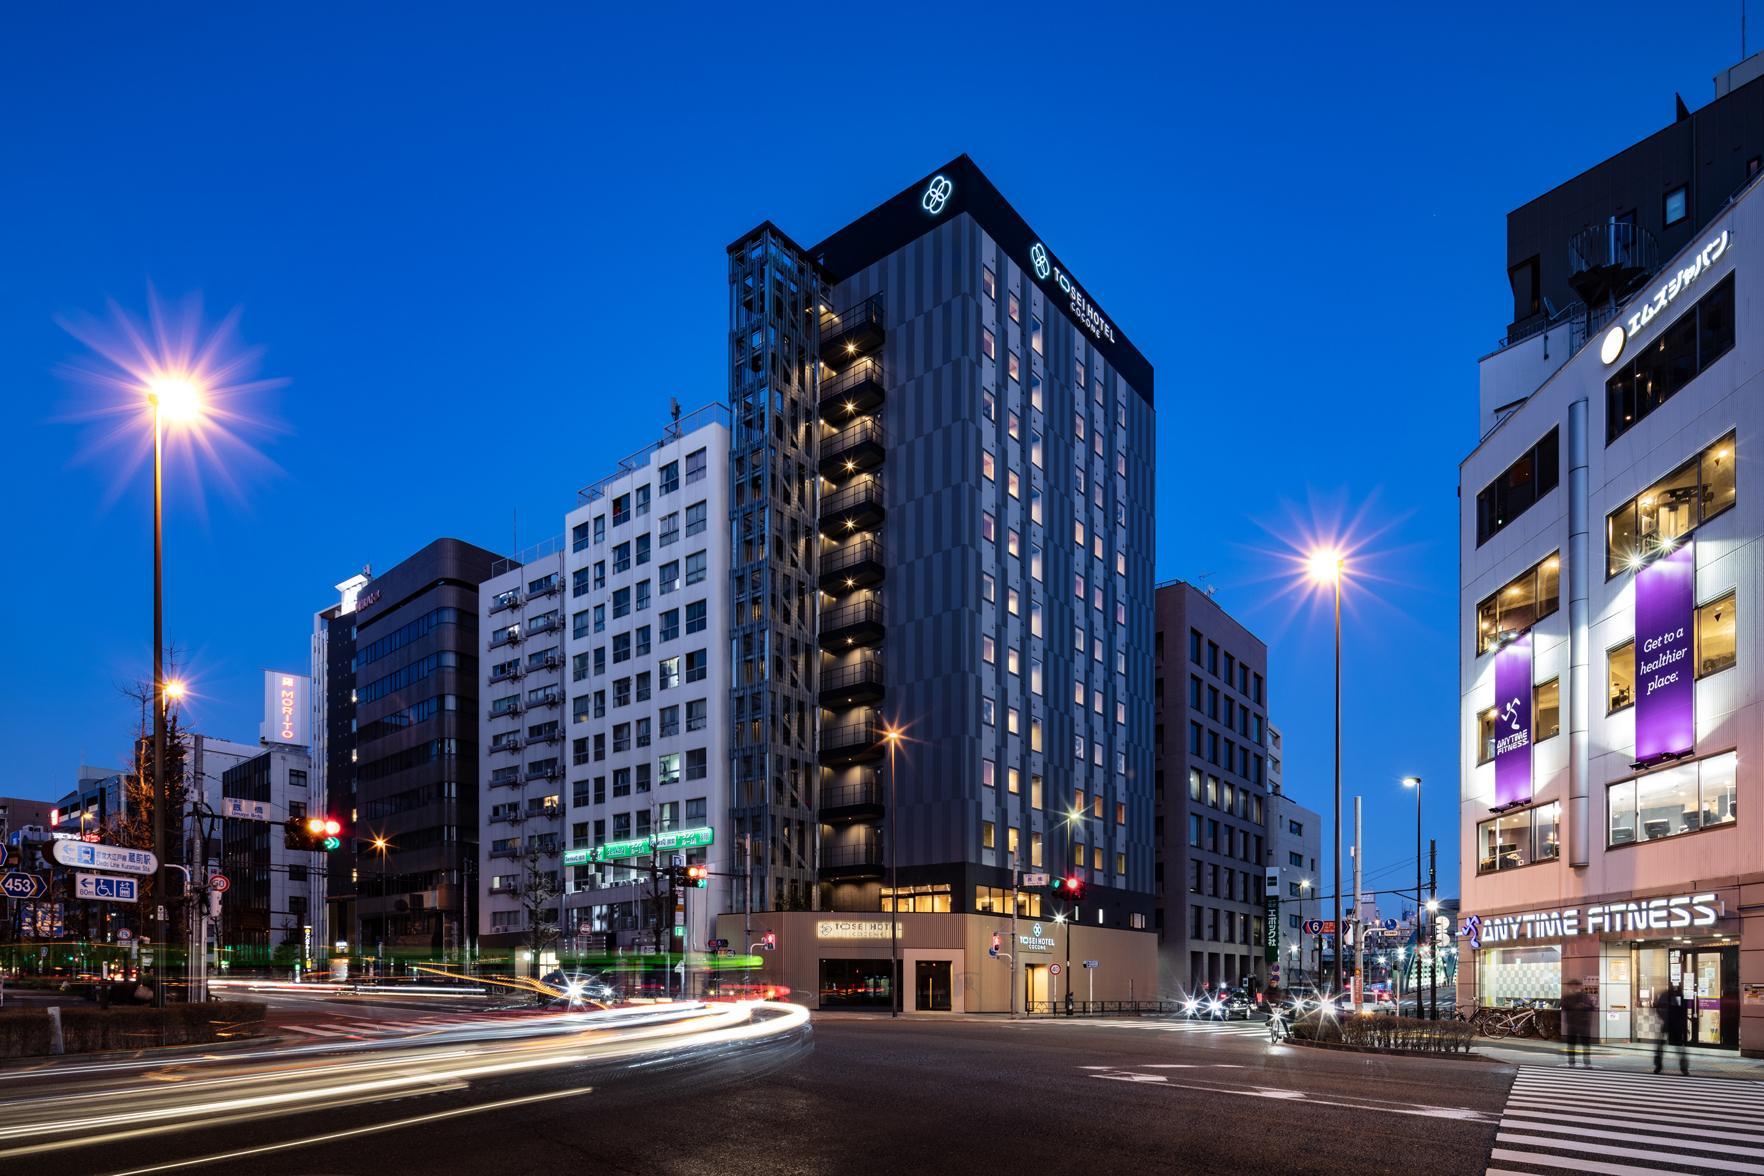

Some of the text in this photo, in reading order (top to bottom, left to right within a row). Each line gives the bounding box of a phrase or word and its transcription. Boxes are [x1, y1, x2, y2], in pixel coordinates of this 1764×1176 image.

[1053, 266, 1115, 344] TOSEI HOTEL
[1070, 301, 1101, 339] COCONE
[1643, 627, 1684, 653] Get to a
[1639, 647, 1688, 676] healthier
[281, 690, 294, 739] MORITO
[1496, 729, 1528, 749] ANYTIME
[4, 878, 31, 893] 453
[835, 923, 903, 931] TOSEI HOTL
[1268, 909, 1276, 947] エポック社
[1312, 922, 1319, 931] 6
[1481, 909, 1579, 942] ANYTIME
[1587, 893, 1717, 934] FITNESS
[1019, 936, 1055, 946] TOSEI HOTEL
